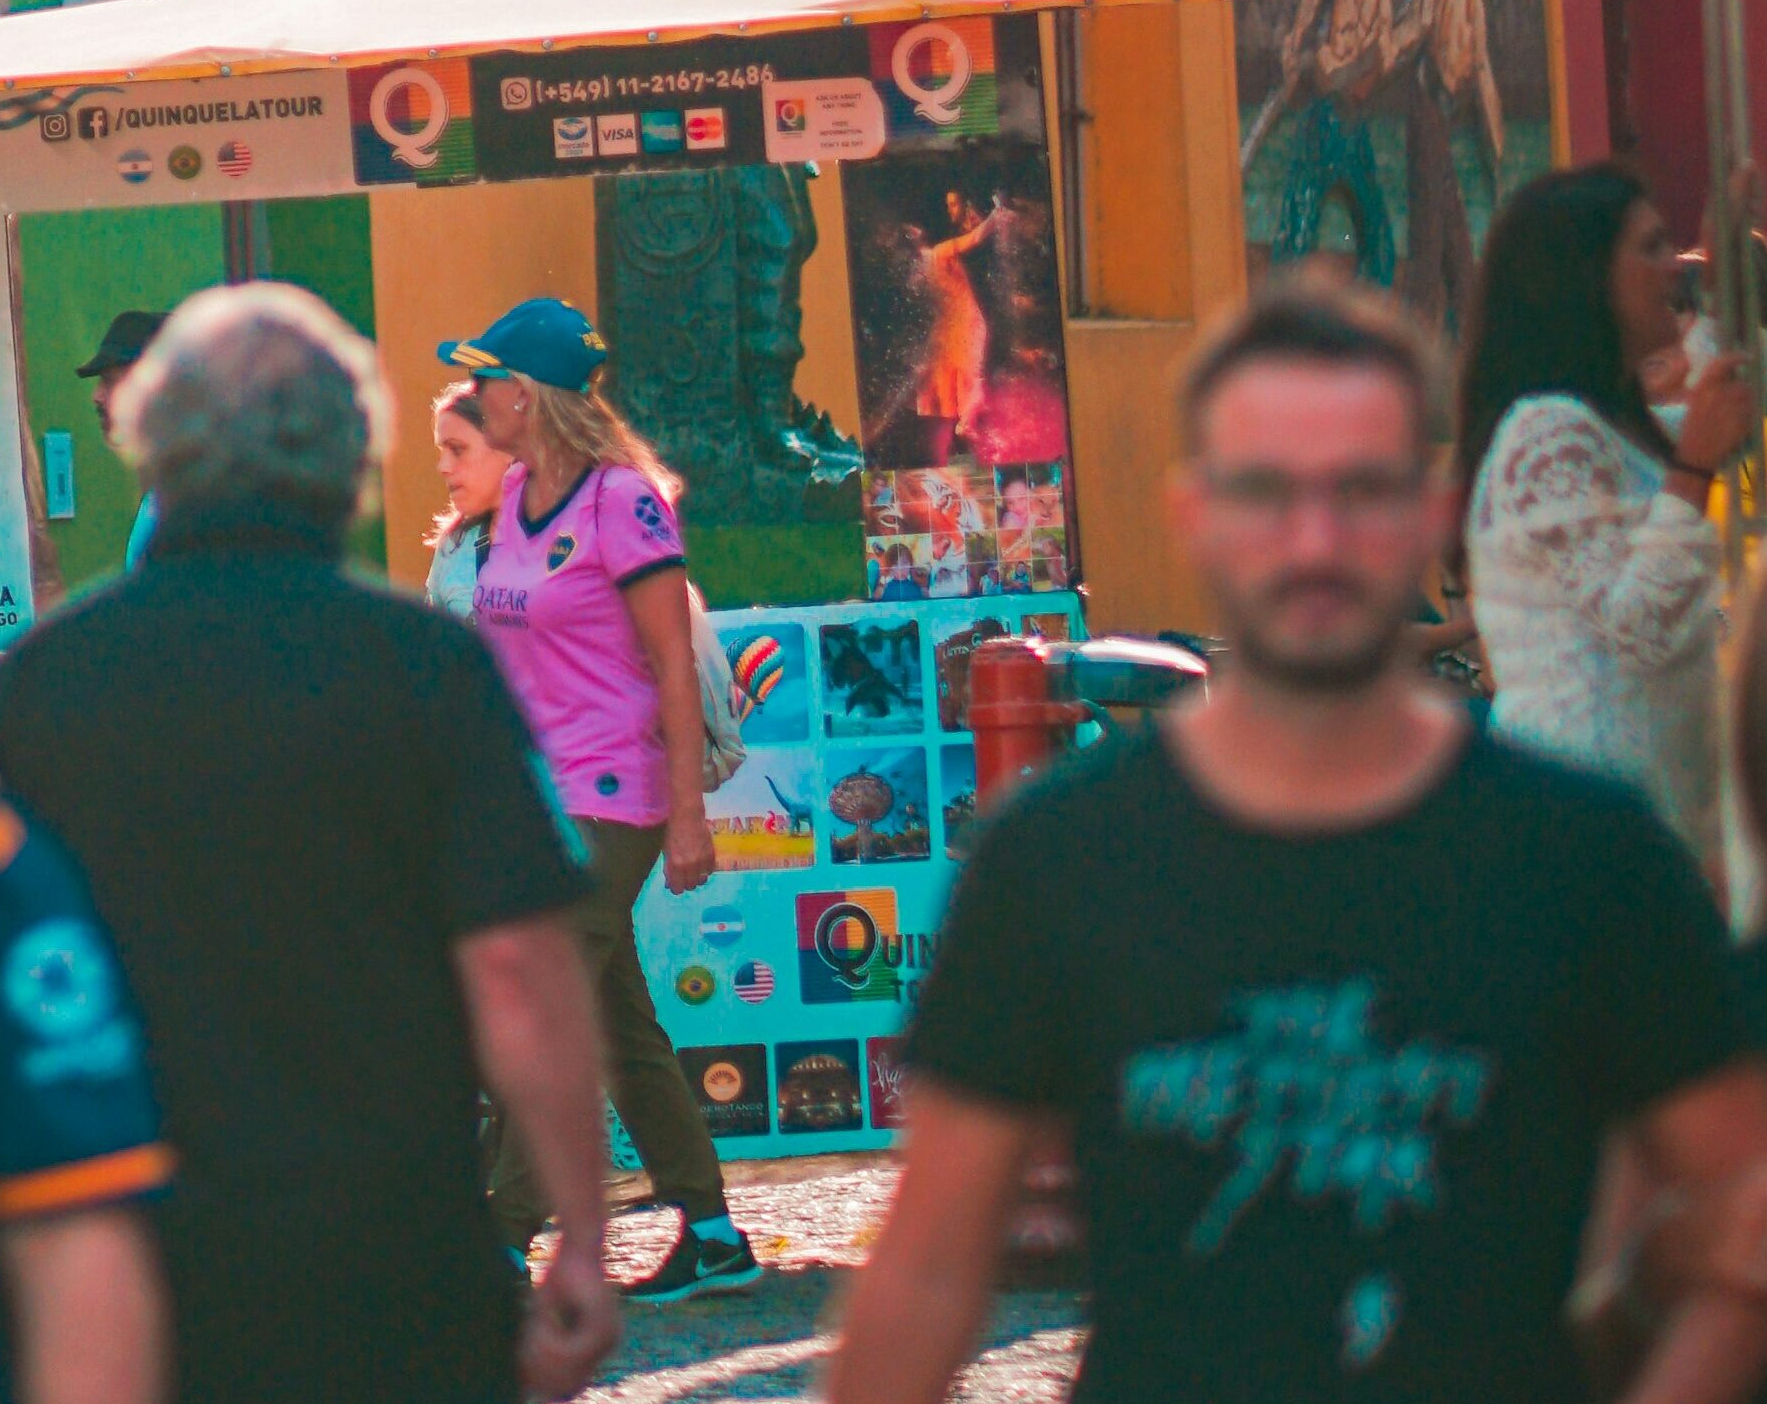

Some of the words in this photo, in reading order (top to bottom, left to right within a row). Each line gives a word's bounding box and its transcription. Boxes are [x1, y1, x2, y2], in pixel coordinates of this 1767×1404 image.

[535, 74, 610, 103] (+549)
[617, 63, 773, 95] 11-2167-2486
[116, 96, 323, 131] /QUINQUELATOUR
[602, 128, 634, 141] VISA
[473, 585, 528, 615] QATAR
